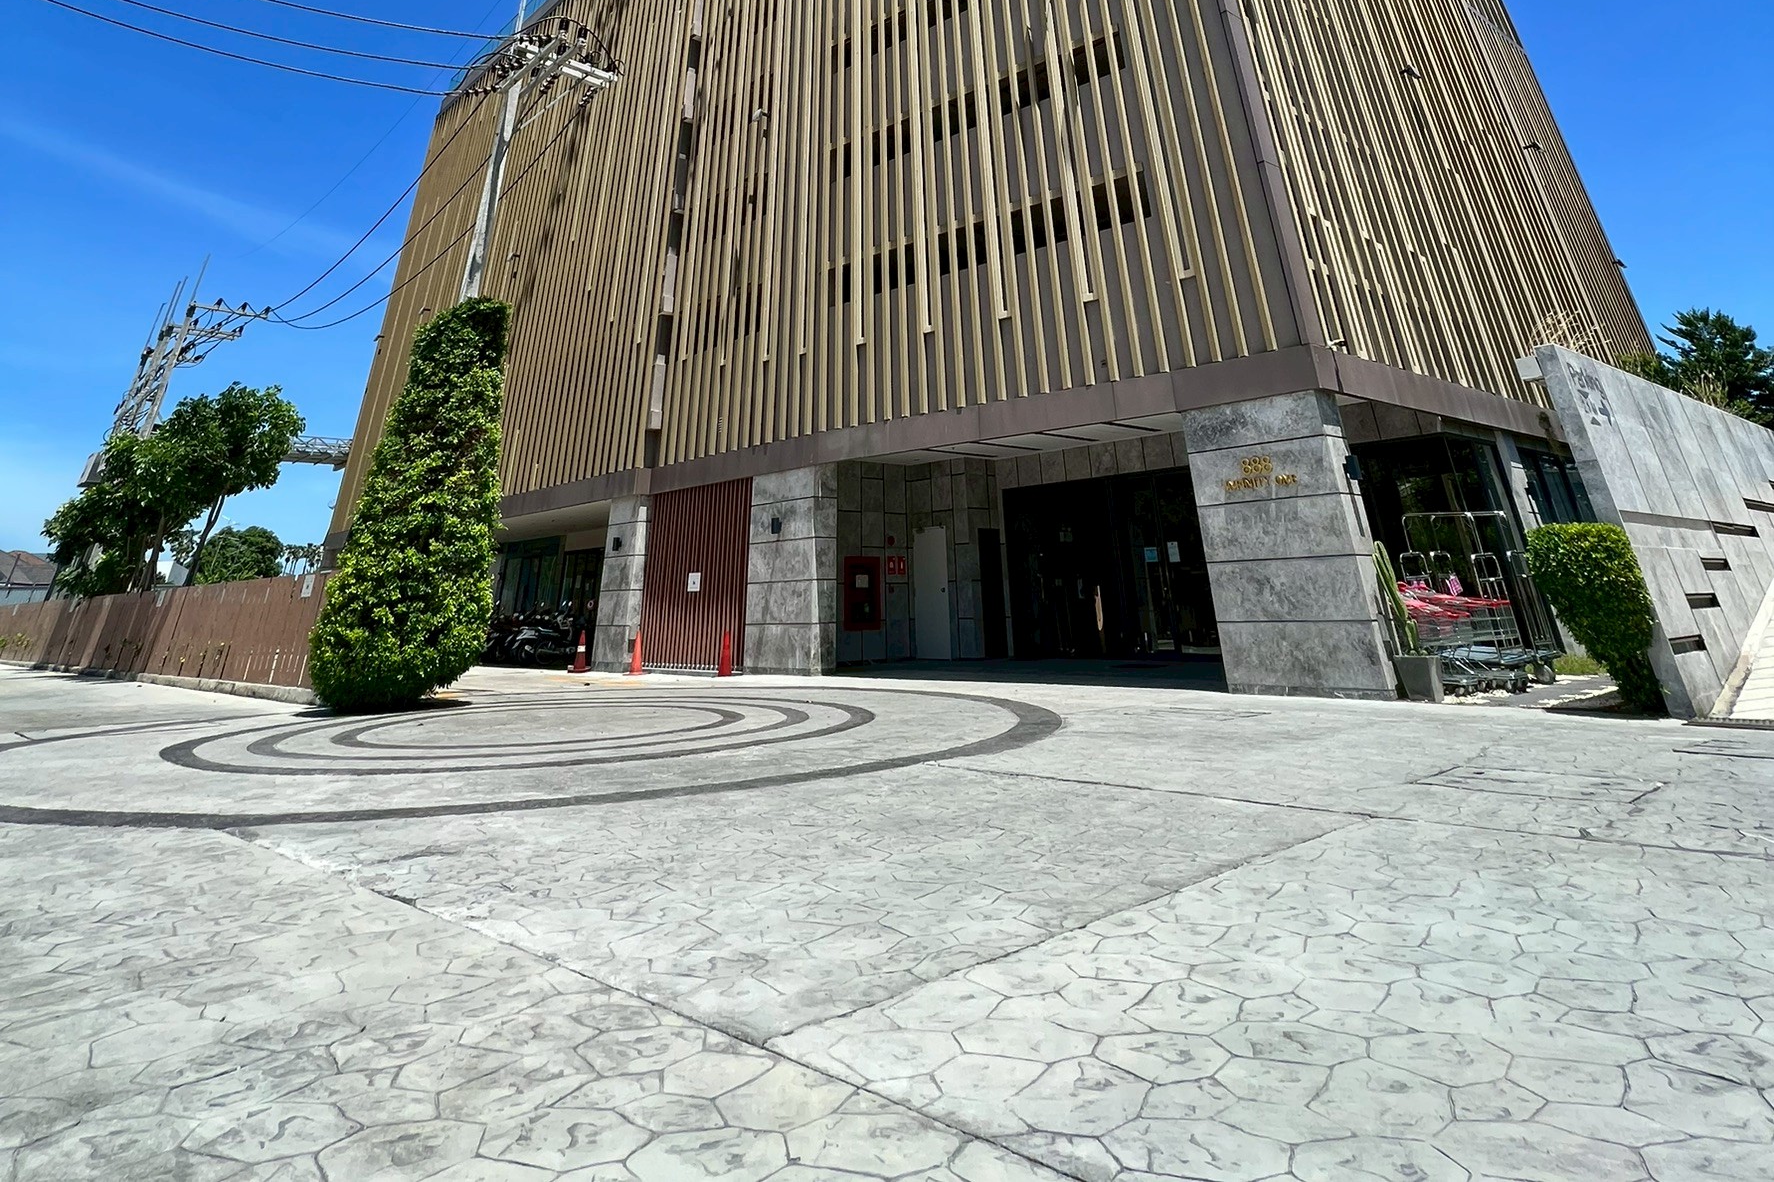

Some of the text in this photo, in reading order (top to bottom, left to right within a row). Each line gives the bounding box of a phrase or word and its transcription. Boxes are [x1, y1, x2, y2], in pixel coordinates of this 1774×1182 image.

[1566, 362, 1607, 400] Parking
[1241, 455, 1273, 476] 888
[1225, 476, 1271, 491] INFINITY
